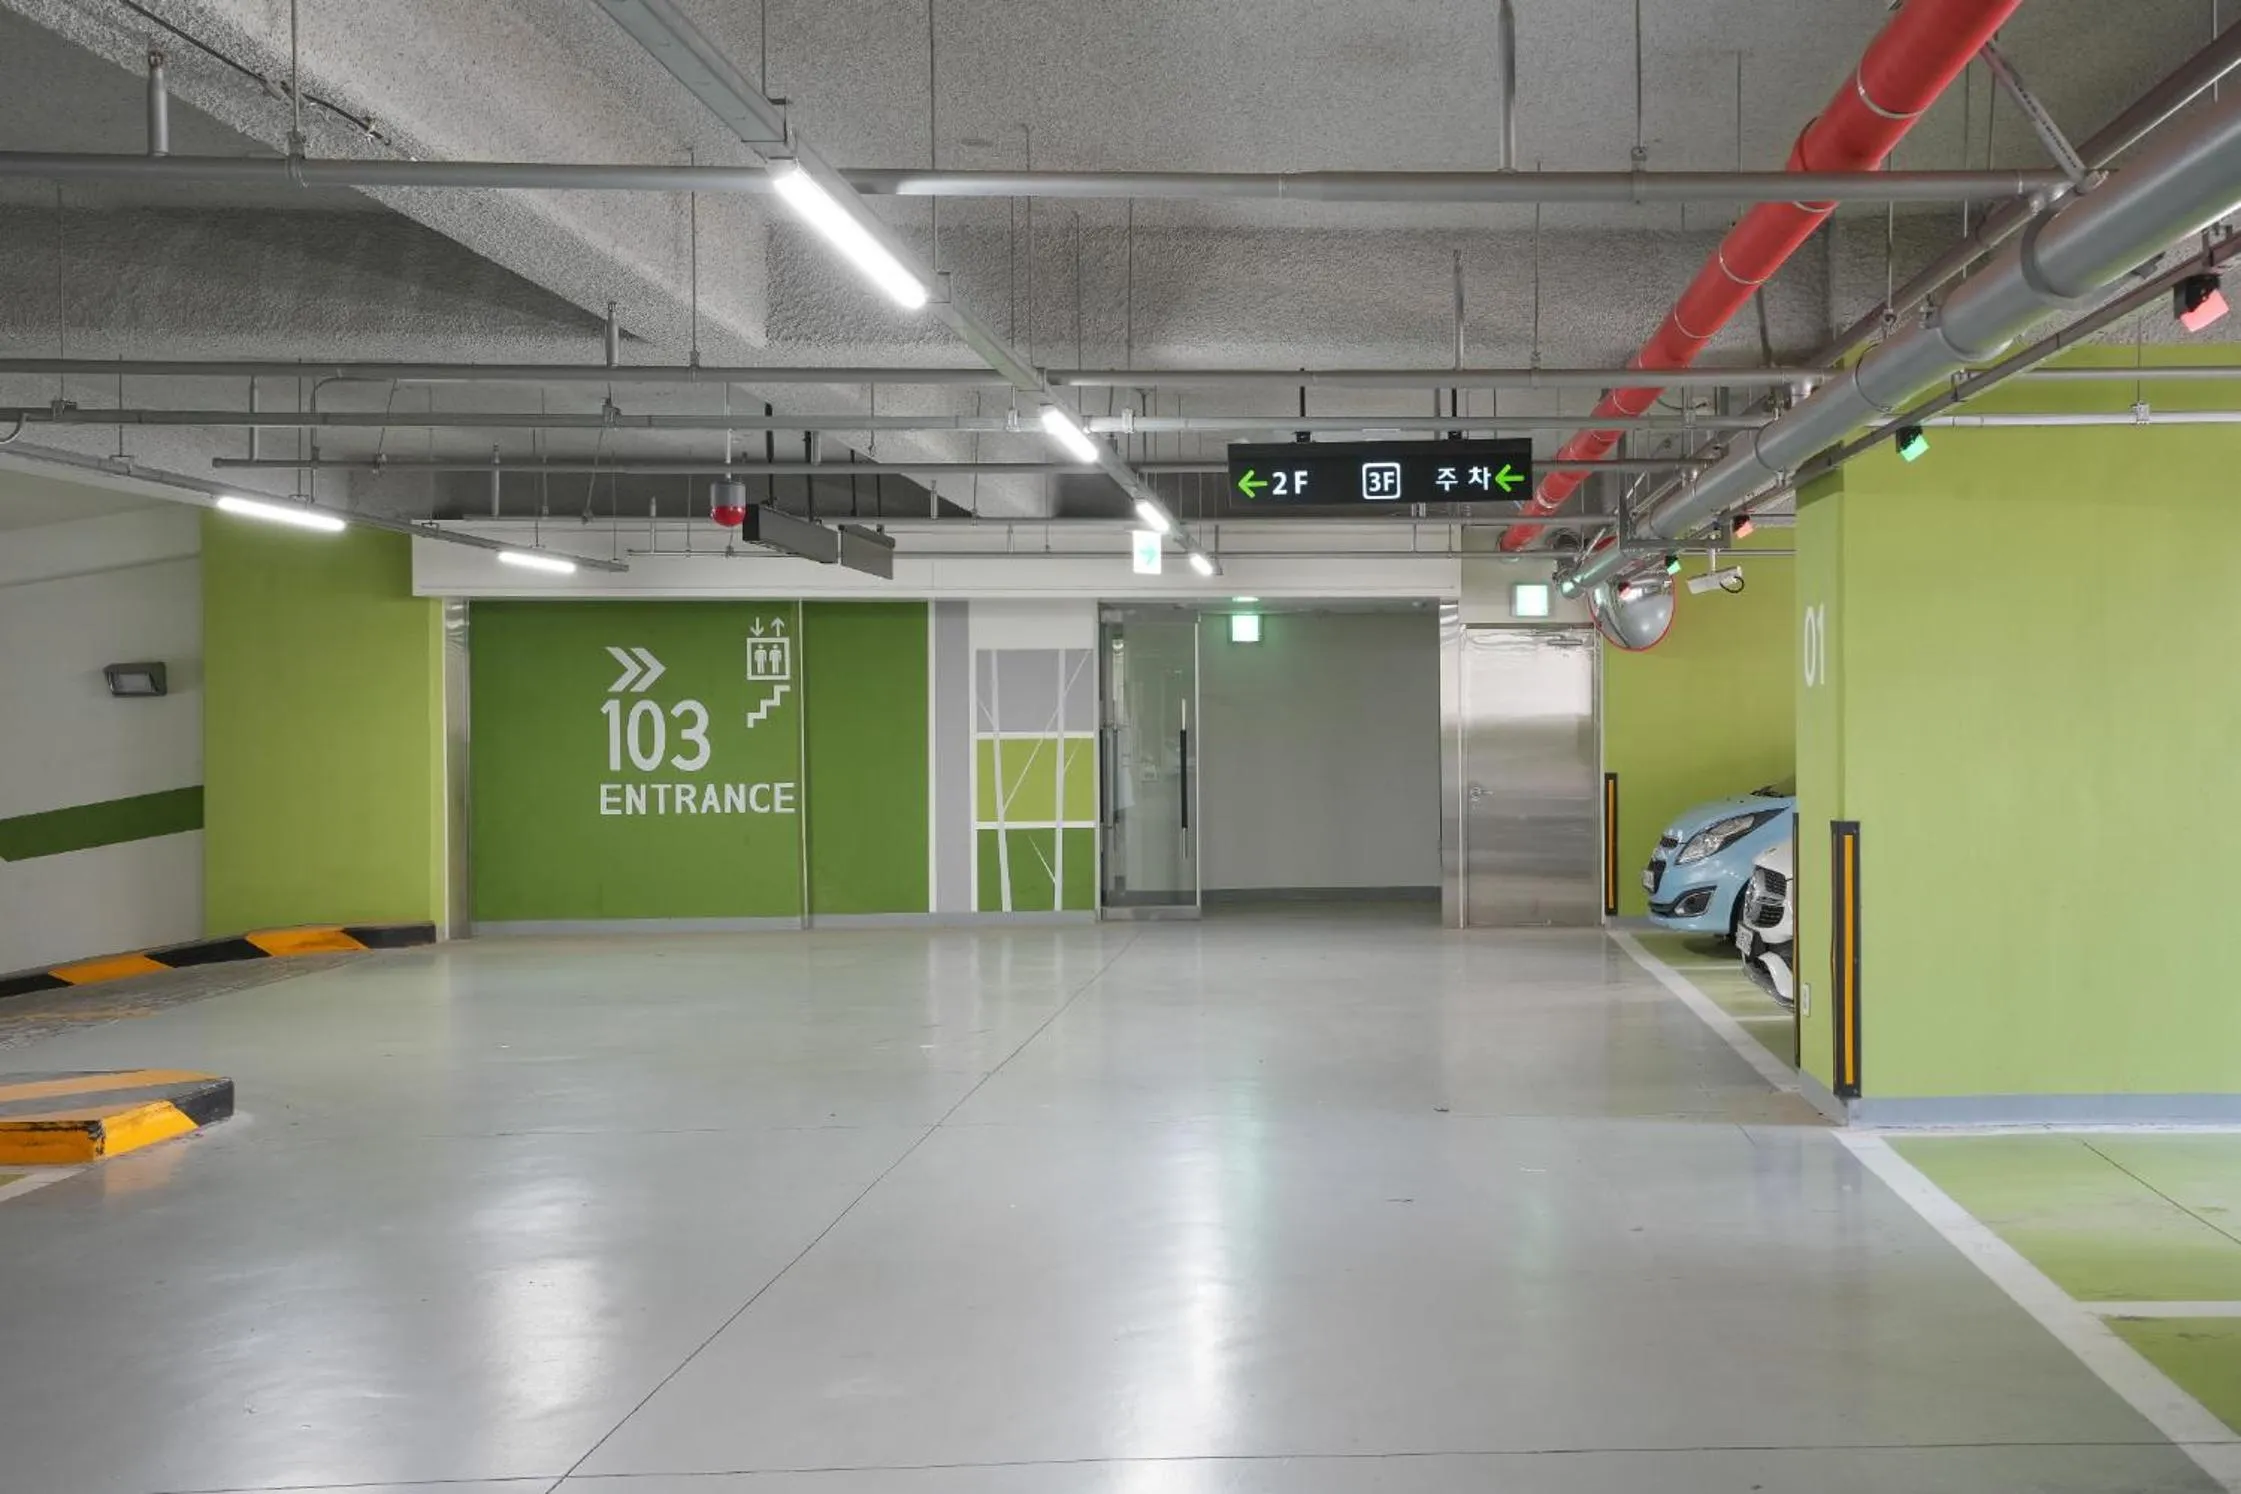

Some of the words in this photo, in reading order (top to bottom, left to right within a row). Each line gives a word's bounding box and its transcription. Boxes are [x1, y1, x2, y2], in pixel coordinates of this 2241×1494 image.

[1272, 470, 1308, 495] 2F
[1368, 471, 1395, 492] 3F
[1804, 603, 1825, 687] 01
[600, 698, 711, 772] 103
[600, 782, 796, 815] ENTRANCE
